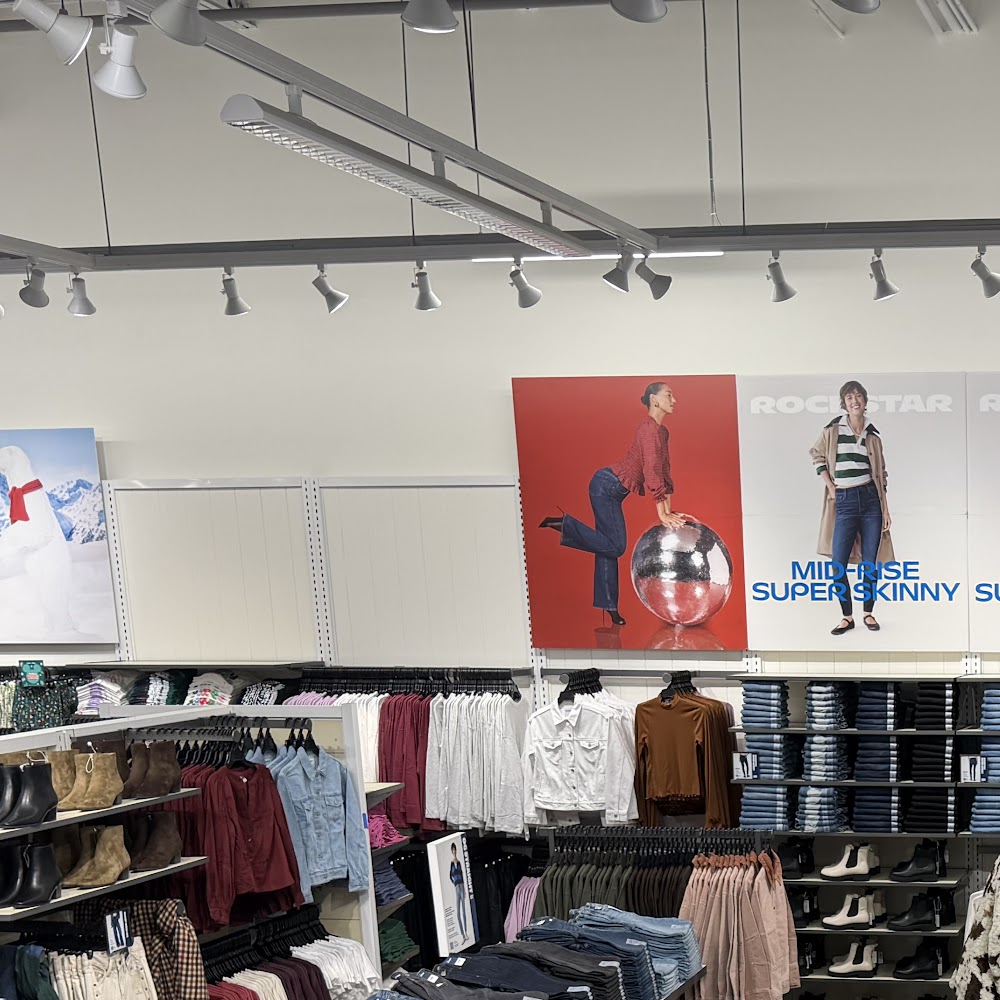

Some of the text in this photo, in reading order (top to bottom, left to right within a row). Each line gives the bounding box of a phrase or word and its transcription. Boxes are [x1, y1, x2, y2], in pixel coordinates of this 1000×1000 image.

[791, 561, 920, 580] MID-RISE
[752, 582, 961, 602] SUPER SKINNY
